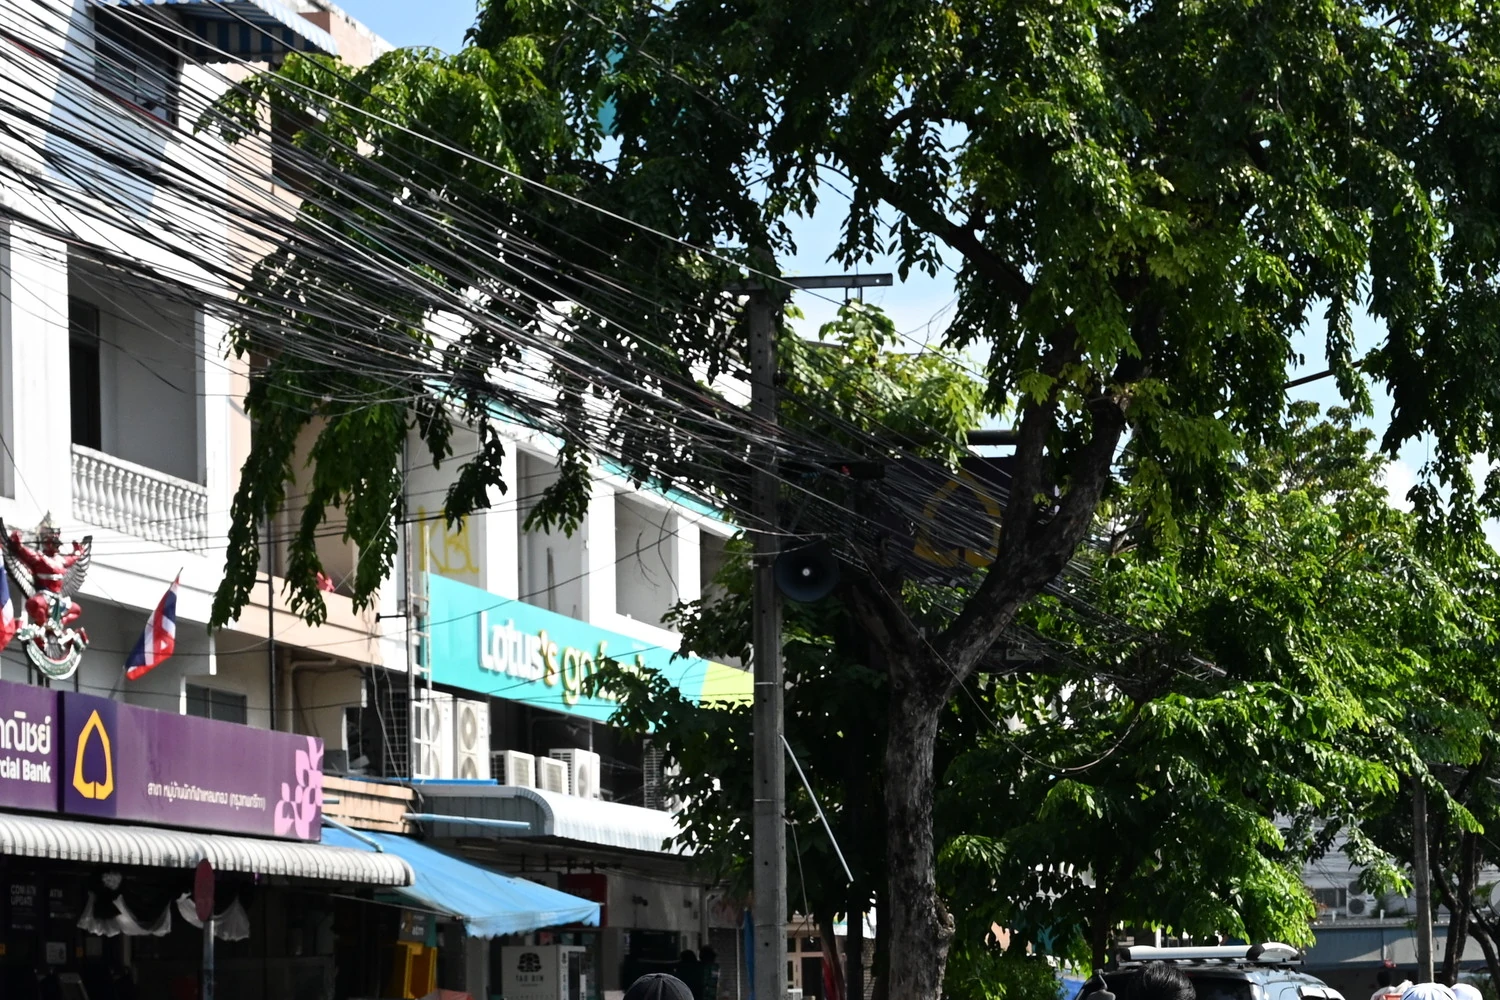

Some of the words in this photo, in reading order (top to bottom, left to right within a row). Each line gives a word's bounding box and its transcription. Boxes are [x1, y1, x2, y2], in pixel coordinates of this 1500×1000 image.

[479, 611, 558, 686] Lotus's
[562, 646, 595, 705] go
[22, 759, 51, 783] Bank
